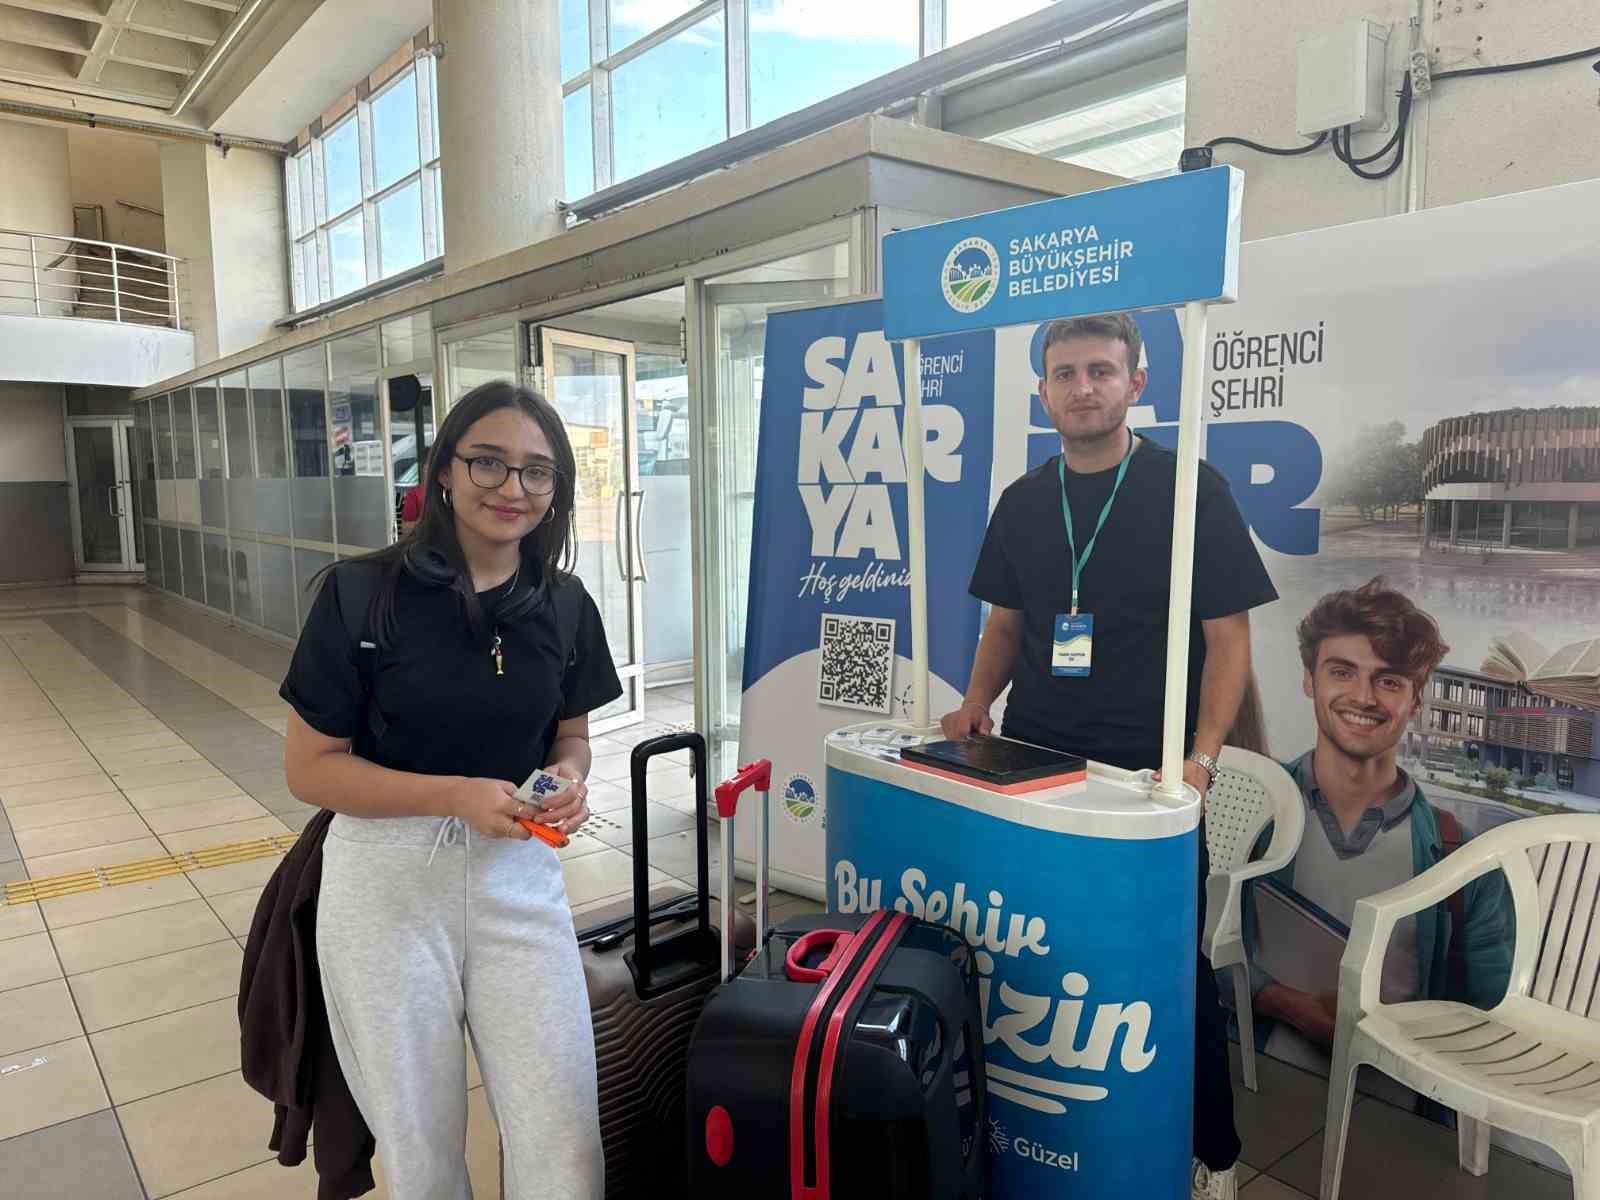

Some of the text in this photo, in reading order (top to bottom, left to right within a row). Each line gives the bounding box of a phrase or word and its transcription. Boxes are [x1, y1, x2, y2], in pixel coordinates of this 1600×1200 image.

[1009, 225, 1099, 255] SAKARYA
[1009, 239, 1133, 276] BÜYÜKŞEHİR
[1009, 261, 1119, 297] BELEDİYESİ
[920, 349, 964, 376] RENCİ
[1212, 321, 1325, 371] ÖĞRENCİ
[803, 330, 902, 410] SA
[921, 375, 944, 398] HRİ
[1210, 368, 1284, 417] ŞEHRİ
[798, 484, 901, 560] YA
[798, 561, 837, 604] Hoş
[835, 860, 882, 914] Bu
[976, 950, 1157, 1073] izin
[1014, 1137, 1079, 1172] Güzel
